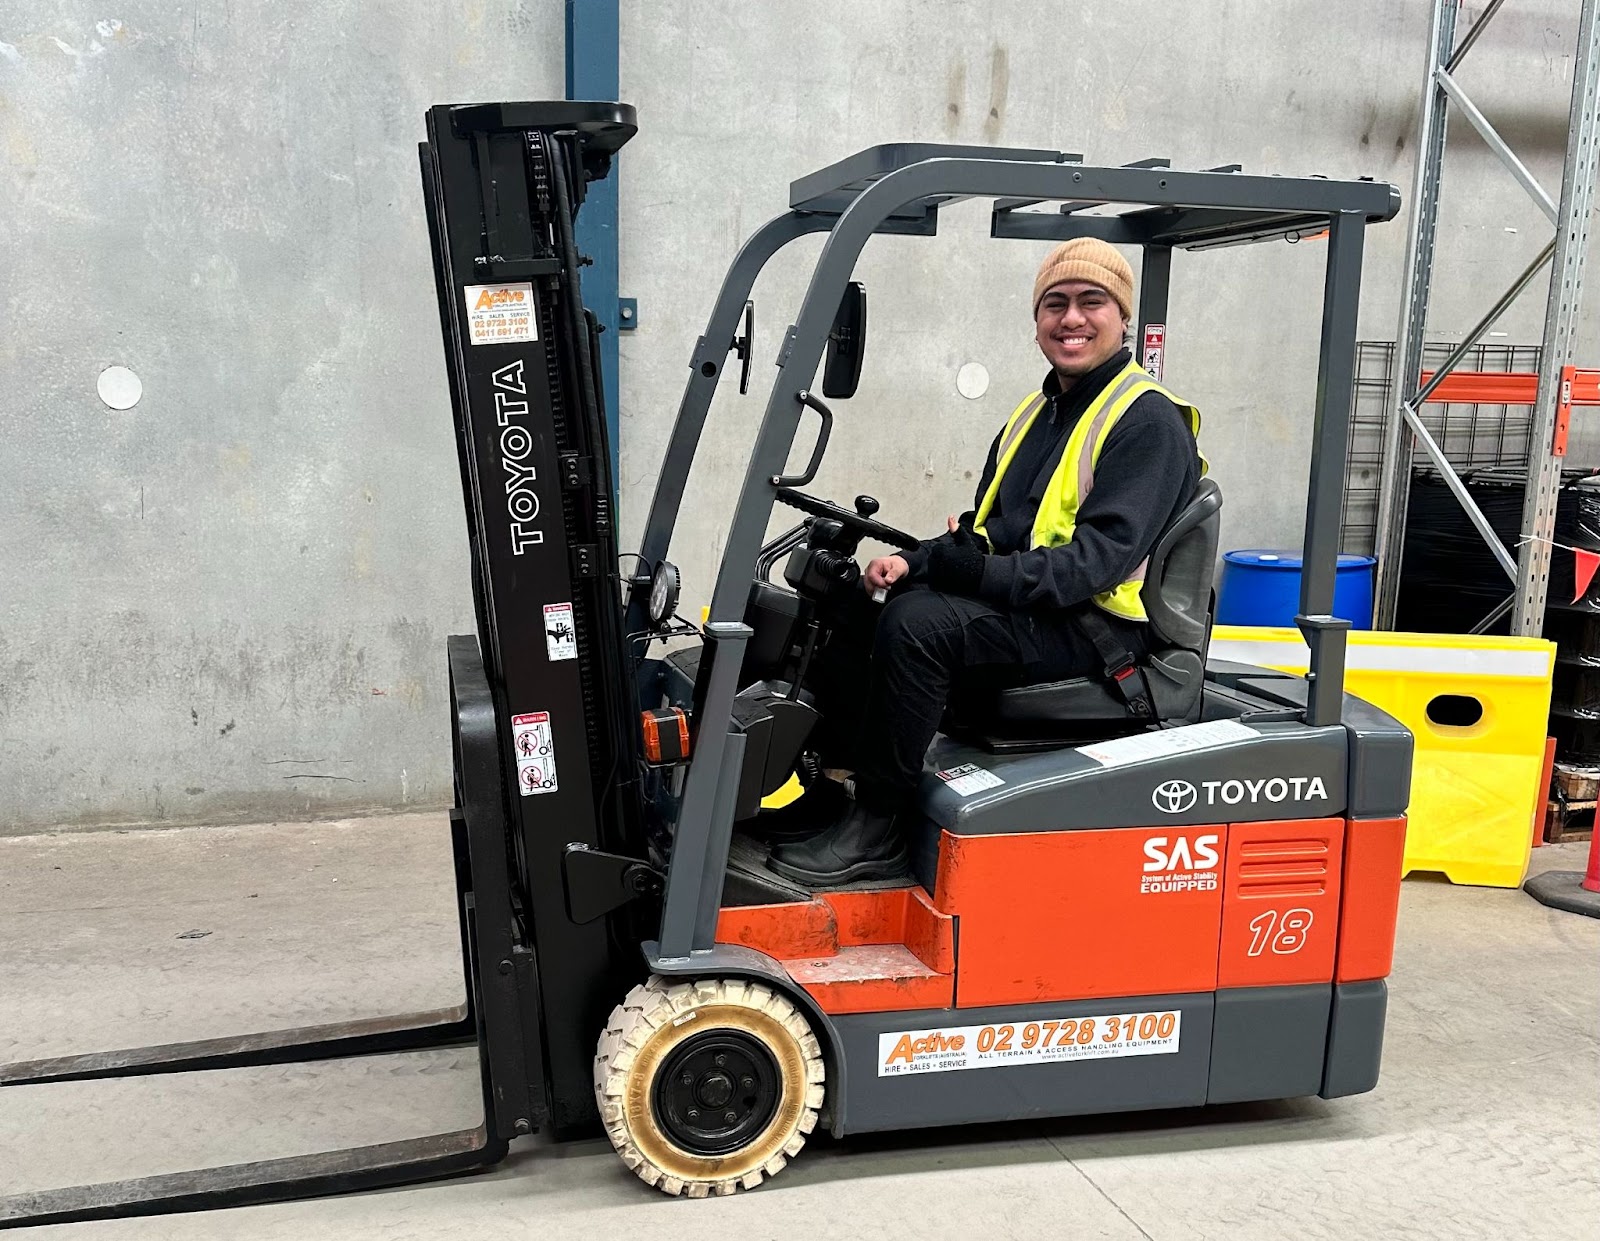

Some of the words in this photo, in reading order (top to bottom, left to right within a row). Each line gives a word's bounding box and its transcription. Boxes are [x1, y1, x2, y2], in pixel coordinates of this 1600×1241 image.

[474, 289, 525, 310] Active
[475, 329, 495, 337] 0411
[514, 327, 528, 335] 471
[487, 319, 507, 327] 9728
[508, 317, 528, 326] 3100
[492, 359, 544, 556] TOYOTA
[1202, 777, 1328, 805] TOYOTA
[1143, 835, 1219, 872] SAS
[1141, 880, 1217, 894] EQUIPPED
[1142, 875, 1164, 883] System
[1172, 873, 1192, 881] Active
[1193, 872, 1217, 881] Stability
[1247, 908, 1314, 957] 18
[976, 1025, 1015, 1052] 02
[1021, 1019, 1096, 1049] 9728
[1102, 1013, 1176, 1043] 3100
[885, 1032, 965, 1064] Active
[997, 1049, 1033, 1058] TERRAIN
[1082, 1042, 1123, 1051] HANDLING
[1126, 1039, 1173, 1048] EQUIPMENT
[885, 1065, 901, 1073] HIRE
[909, 1063, 931, 1071] SALES
[938, 1059, 967, 1068] SERVICE
